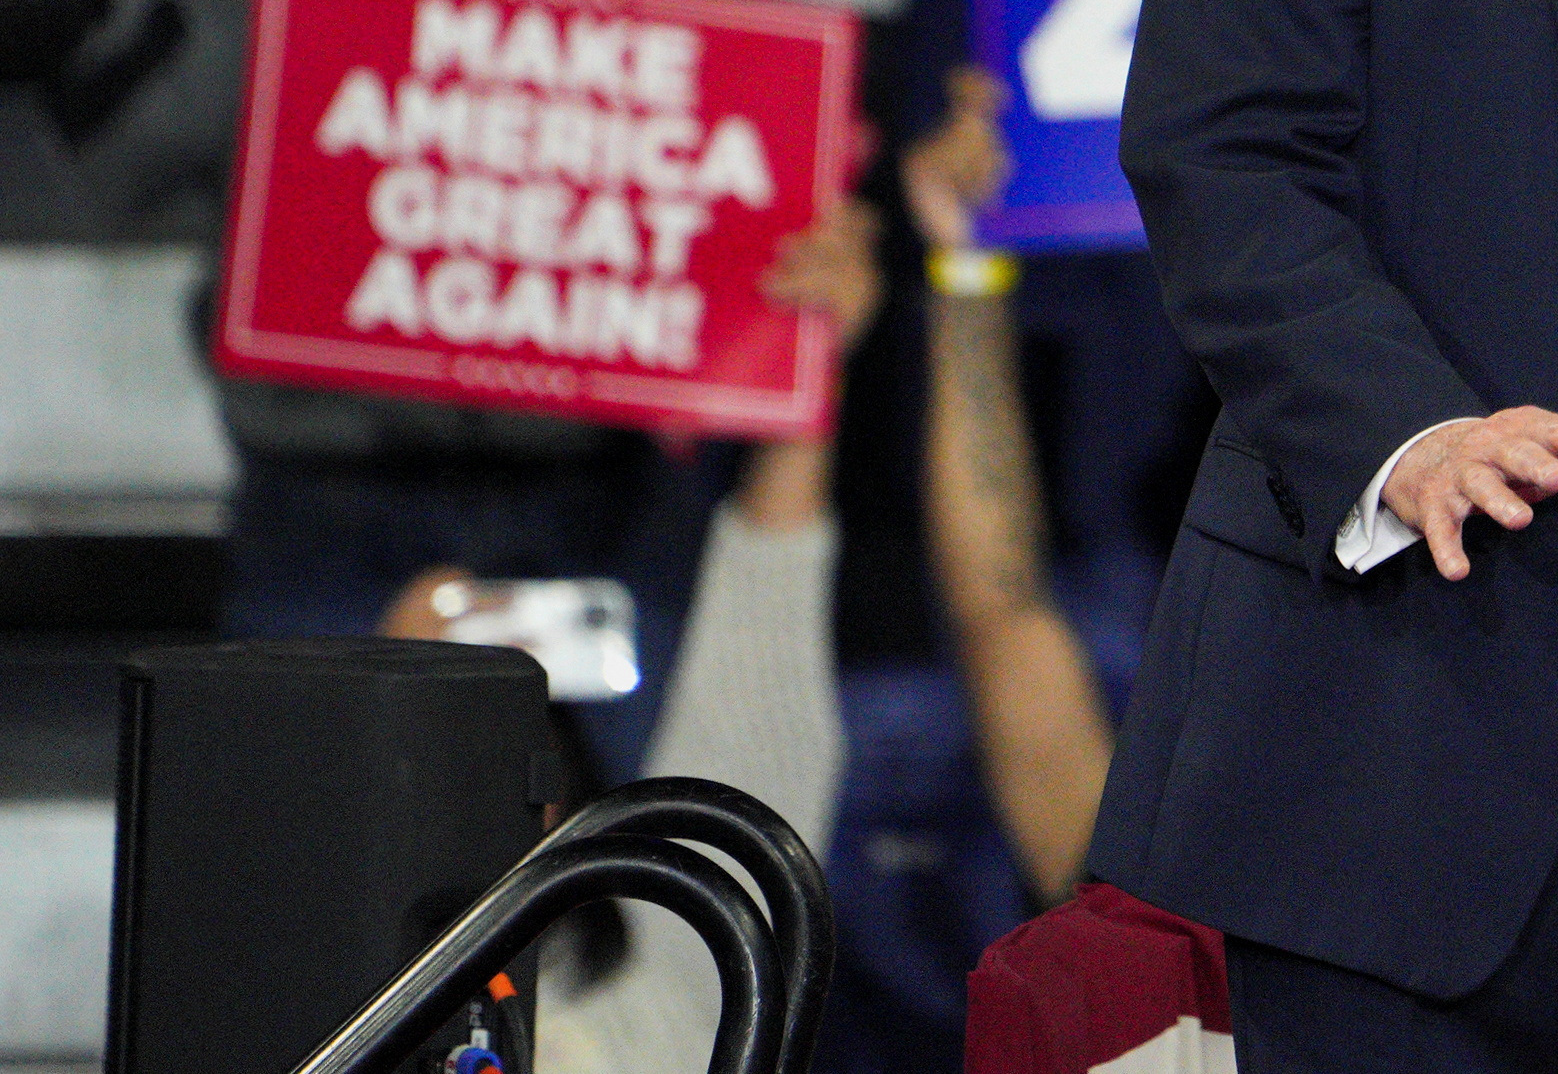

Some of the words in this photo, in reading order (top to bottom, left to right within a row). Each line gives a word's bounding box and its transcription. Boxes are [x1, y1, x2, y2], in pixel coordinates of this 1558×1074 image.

[314, 65, 777, 209] AMERICA
[366, 162, 713, 276] GREAT
[343, 248, 704, 372] AGAIN!
